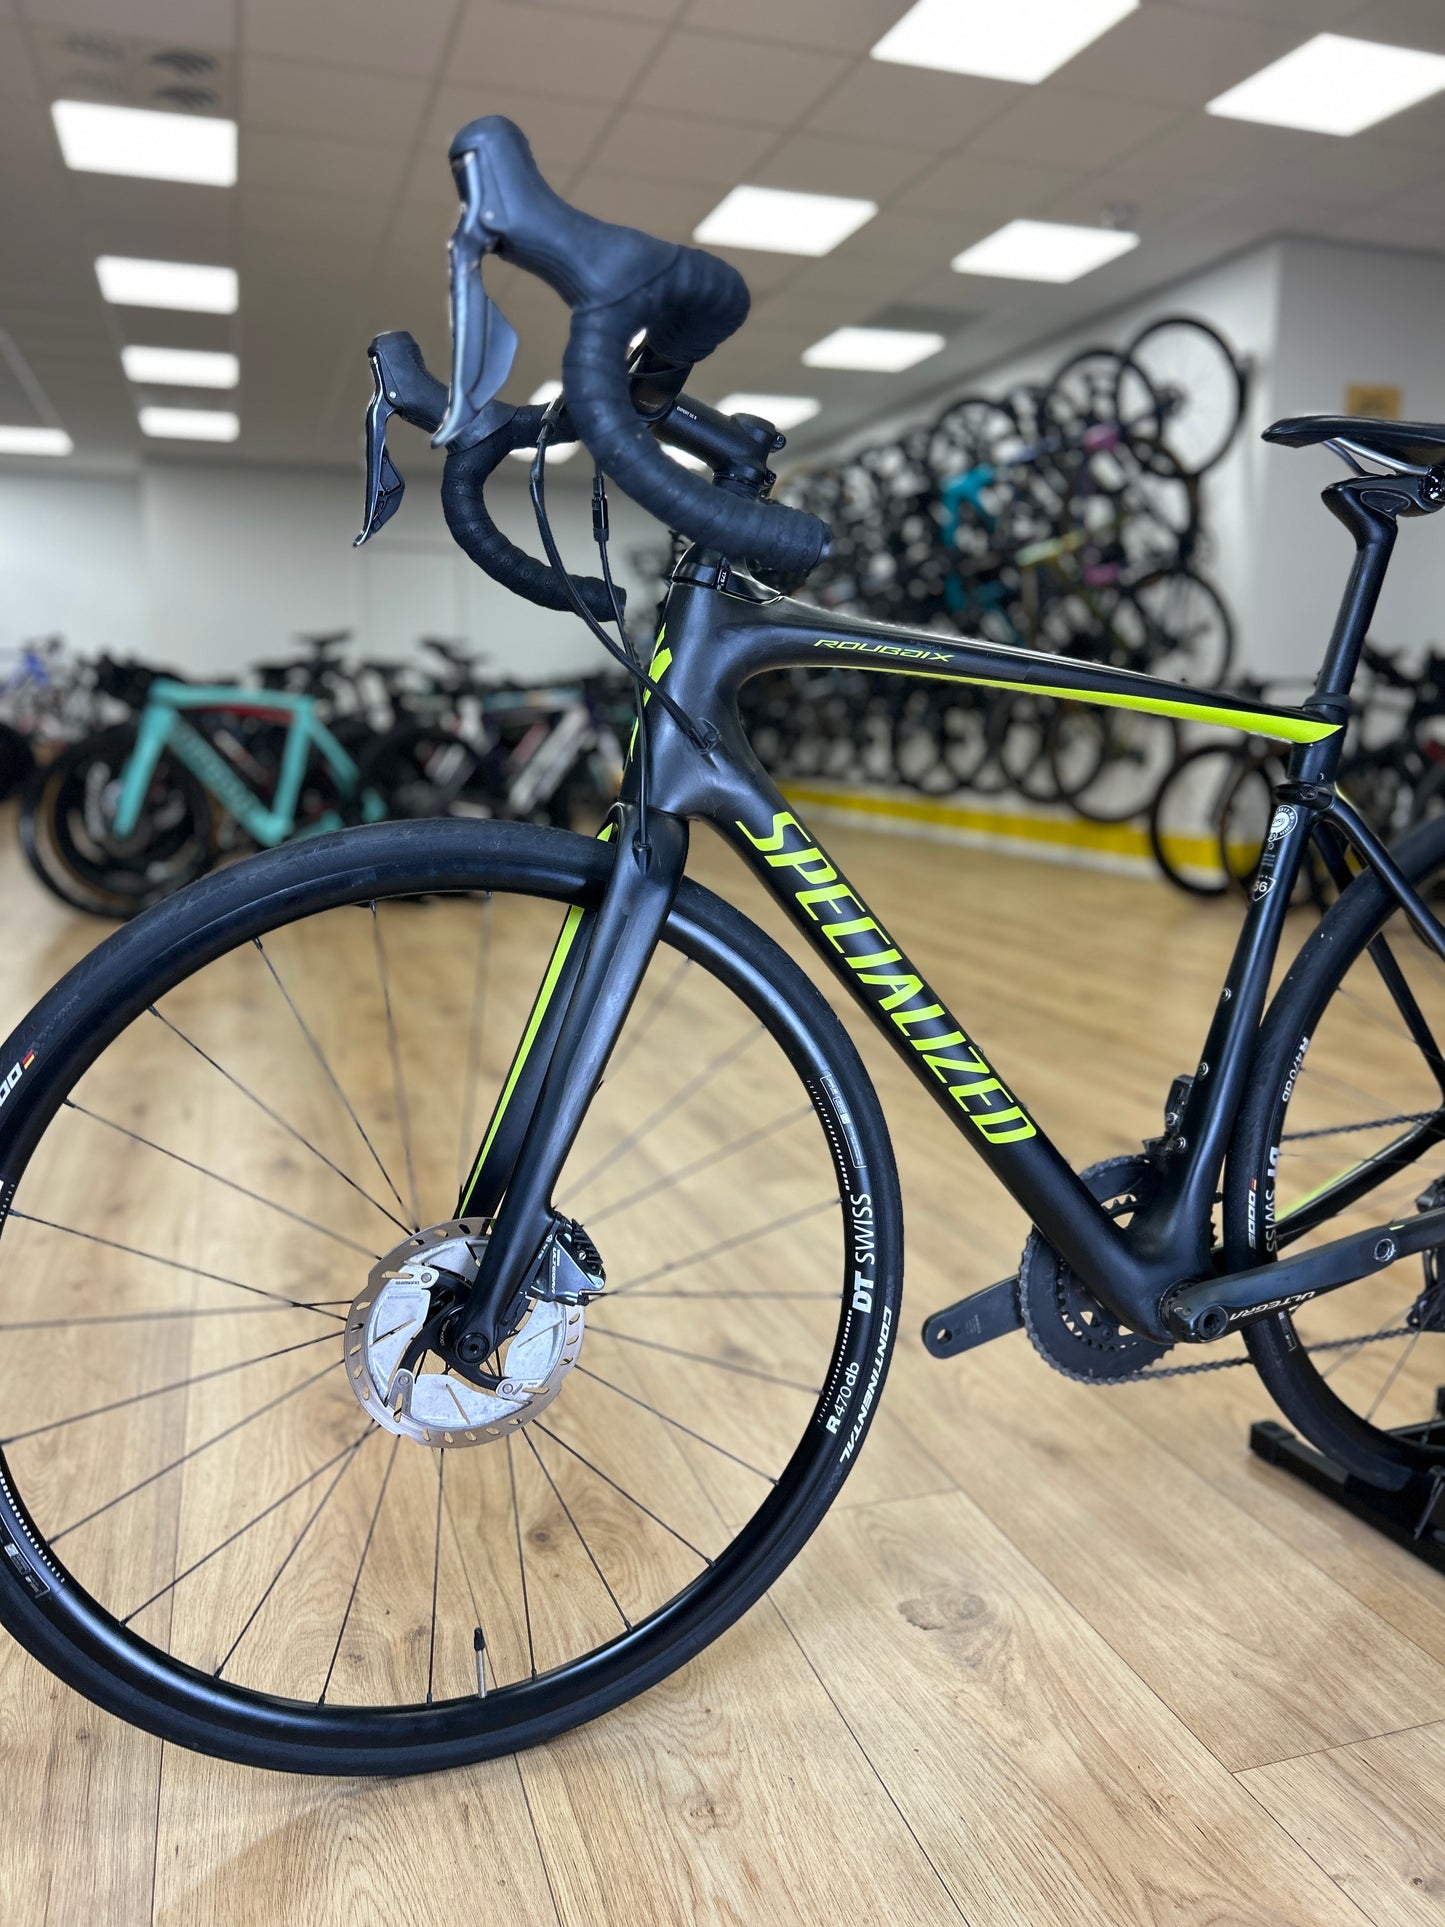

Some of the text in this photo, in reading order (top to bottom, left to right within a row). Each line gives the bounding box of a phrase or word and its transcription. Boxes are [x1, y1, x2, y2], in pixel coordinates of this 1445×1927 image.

[735, 811, 1037, 1144] SPECIALIZED
[850, 1193, 875, 1314] DT SWISS
[1229, 1290, 1316, 1321] ULTEGRA
[839, 1304, 892, 1464] CONTINENTAL
